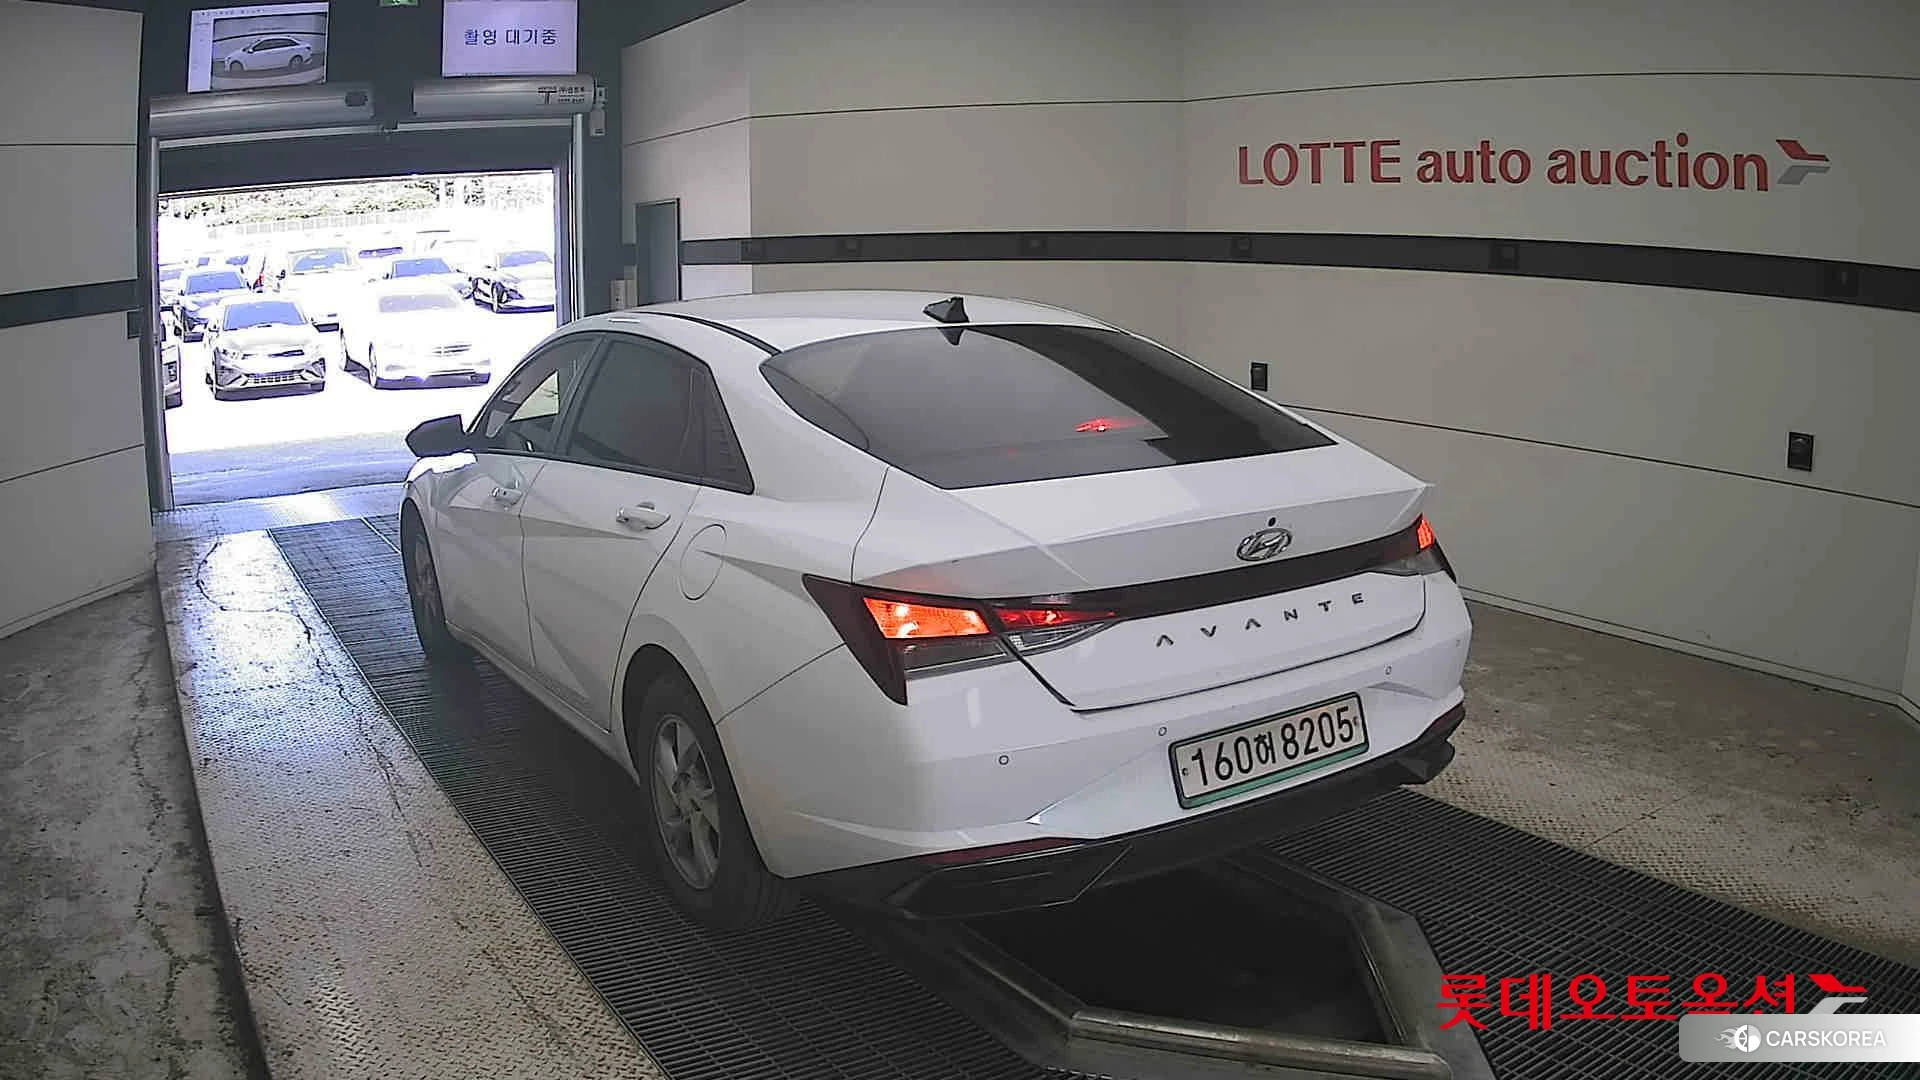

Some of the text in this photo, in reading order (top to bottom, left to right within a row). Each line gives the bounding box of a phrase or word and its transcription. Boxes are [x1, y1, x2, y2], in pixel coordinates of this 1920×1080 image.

[505, 29, 558, 45] 대기중
[1238, 132, 1769, 192] LOTTE auto auction
[1156, 593, 1364, 648] AVANTE
